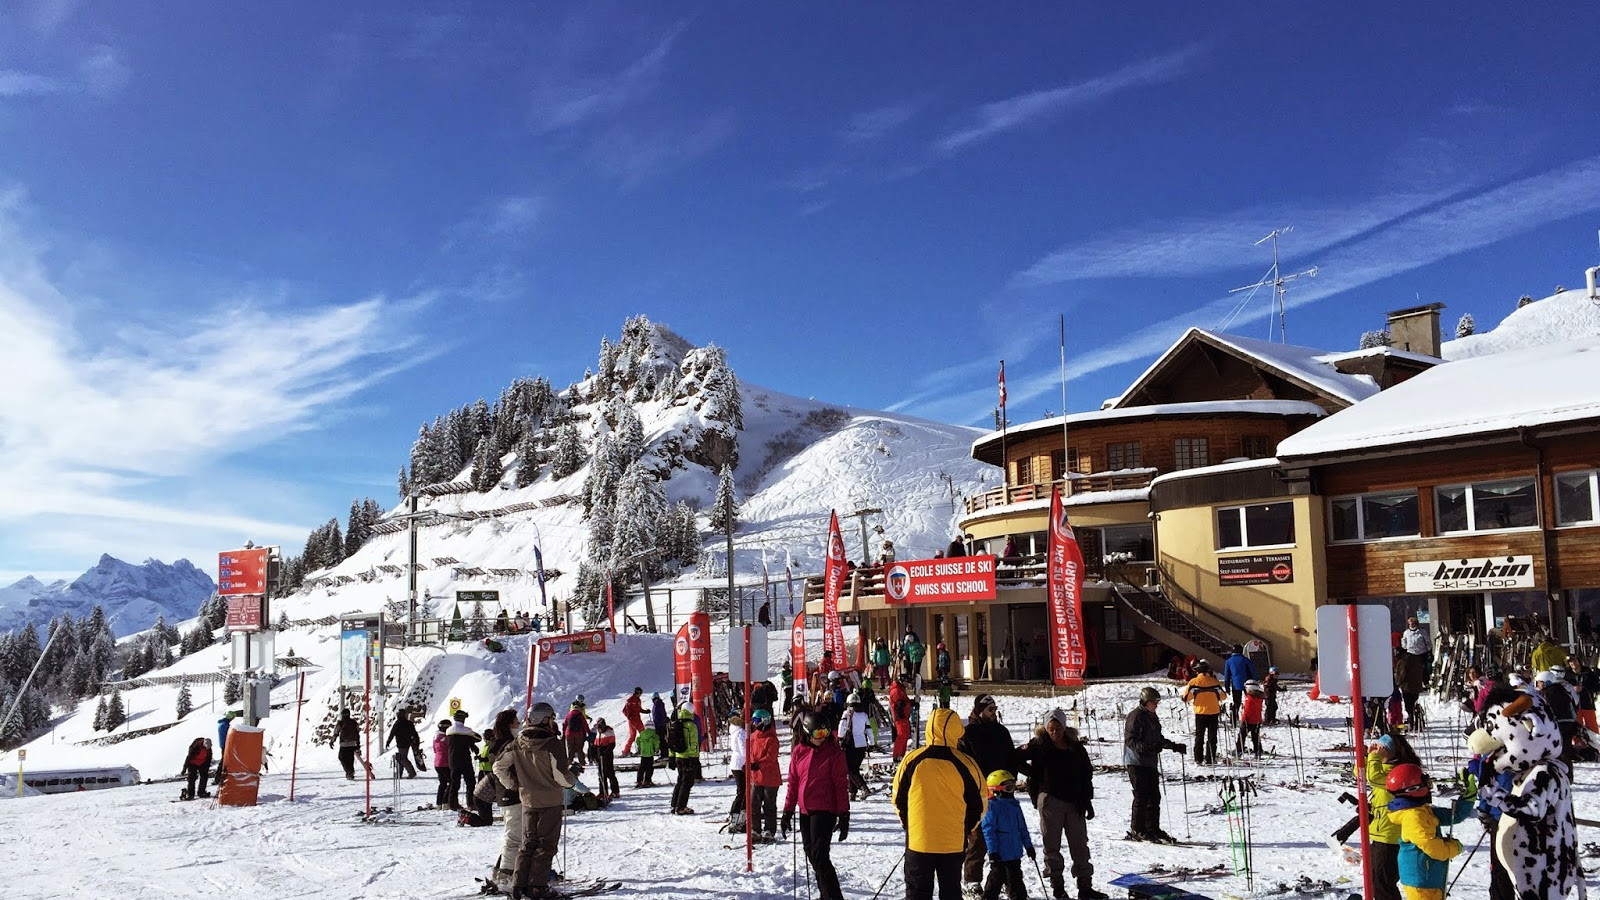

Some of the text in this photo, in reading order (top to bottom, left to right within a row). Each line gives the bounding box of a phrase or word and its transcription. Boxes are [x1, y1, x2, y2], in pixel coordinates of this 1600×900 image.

[910, 560, 992, 578] ECOLE SUISSE DE SKI
[914, 580, 989, 596] SWISS SKI SCHOOL
[1054, 584, 1067, 625] SUISSE
[1058, 628, 1069, 665] ECOLE
[1071, 651, 1083, 665] ET
